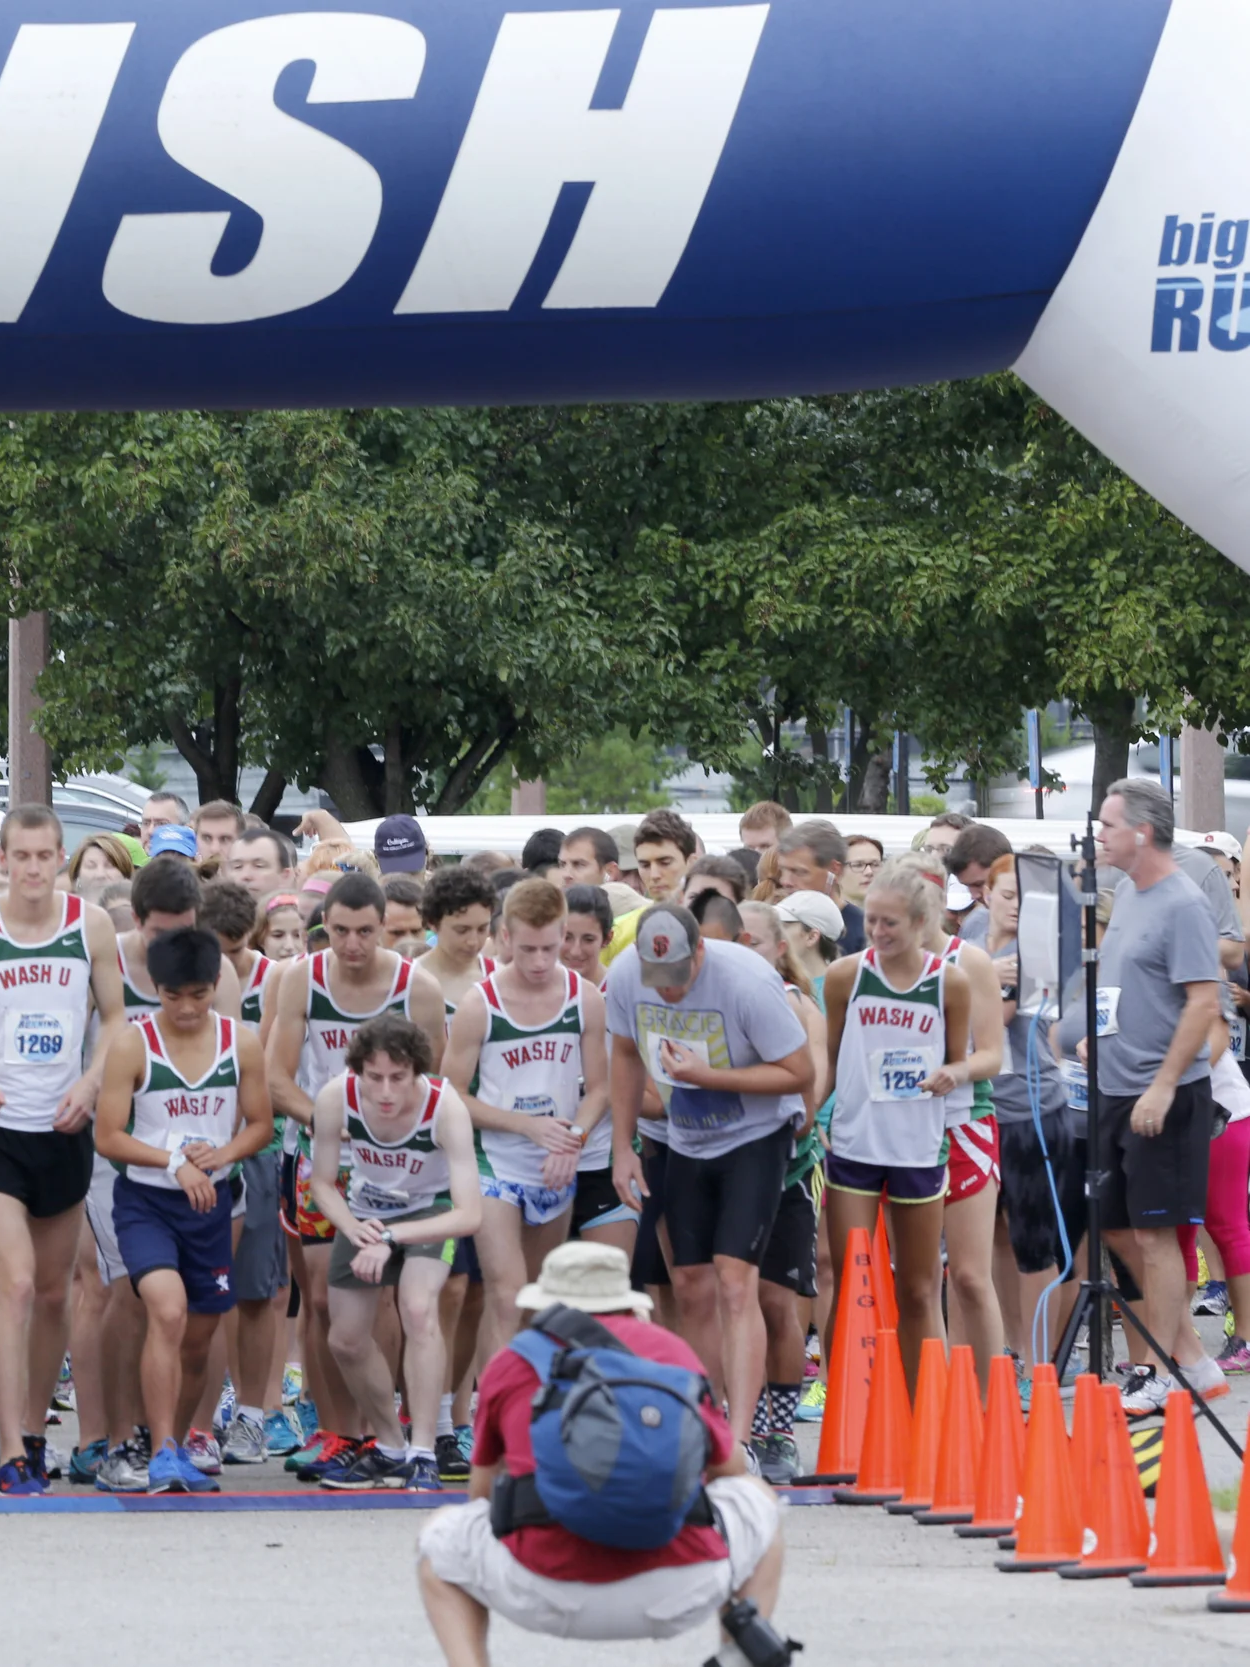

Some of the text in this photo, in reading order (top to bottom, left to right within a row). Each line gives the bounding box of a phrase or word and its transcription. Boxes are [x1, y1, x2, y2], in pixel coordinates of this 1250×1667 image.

[1158, 212, 1249, 270] big
[58, 966, 71, 987] U
[859, 1006, 934, 1034] WASH U
[321, 1028, 357, 1050] WA
[501, 1041, 574, 1069] WASH U
[164, 1094, 209, 1119] WASH
[357, 1147, 424, 1175] WASH U
[855, 1253, 875, 1308] BIG
